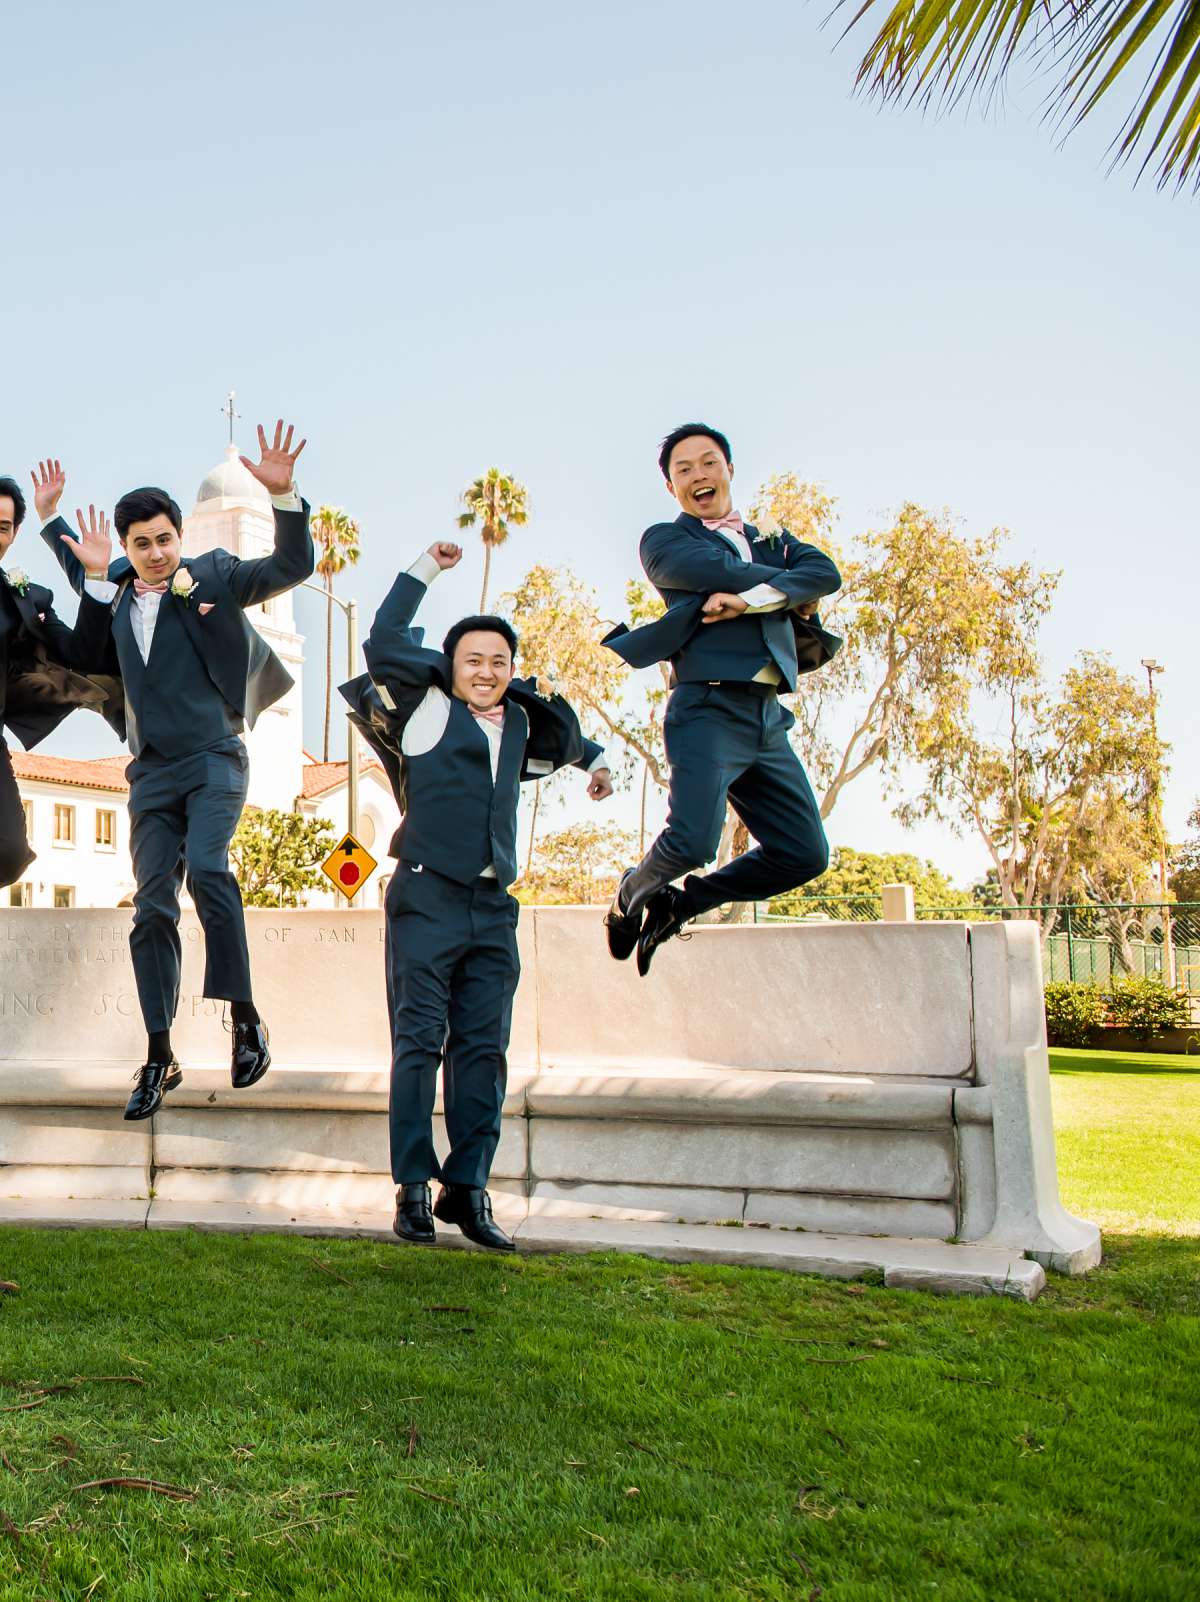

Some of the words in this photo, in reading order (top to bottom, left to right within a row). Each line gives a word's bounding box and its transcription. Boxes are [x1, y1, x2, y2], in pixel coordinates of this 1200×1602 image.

[96, 926, 128, 942] TH
[264, 928, 292, 942] OF
[316, 927, 355, 942] SAN
[0, 948, 127, 963] APPRECIATI
[94, 993, 217, 1017] SCPS
